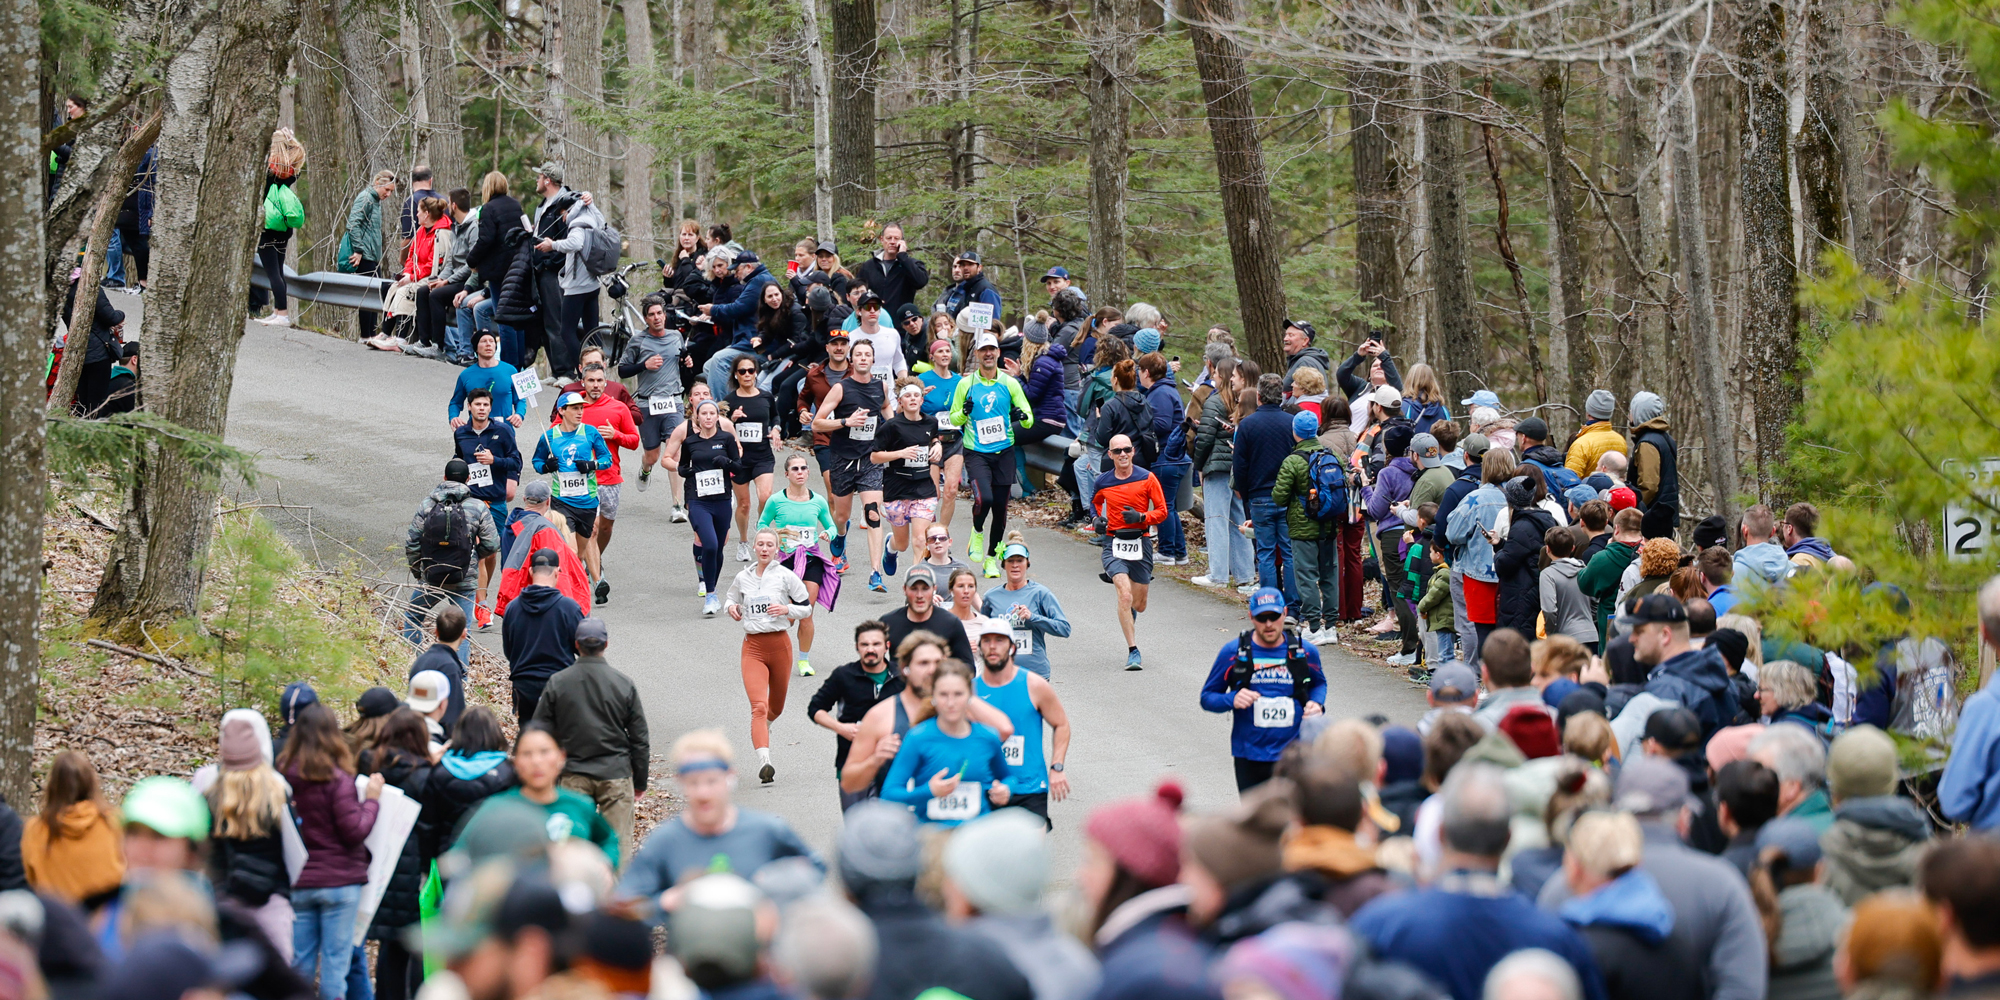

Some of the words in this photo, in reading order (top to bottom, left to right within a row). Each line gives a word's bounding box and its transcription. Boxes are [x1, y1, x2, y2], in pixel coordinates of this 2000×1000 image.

[972, 315, 988, 324] 1:45
[516, 375, 536, 386] CHRIS
[520, 380, 537, 393] 1:45
[652, 401, 673, 411] 1024
[738, 429, 760, 438] 1617
[855, 424, 874, 432] 459
[980, 423, 1003, 436] 1663
[471, 469, 489, 480] 332
[563, 478, 585, 489] 1664
[699, 477, 721, 487] 1531
[799, 530, 810, 539] 13
[1116, 543, 1139, 552] 1370
[750, 603, 770, 614] 138
[1014, 638, 1027, 649] 51
[1262, 708, 1287, 720] 629
[1002, 746, 1019, 758] 88
[939, 796, 968, 810] 894
